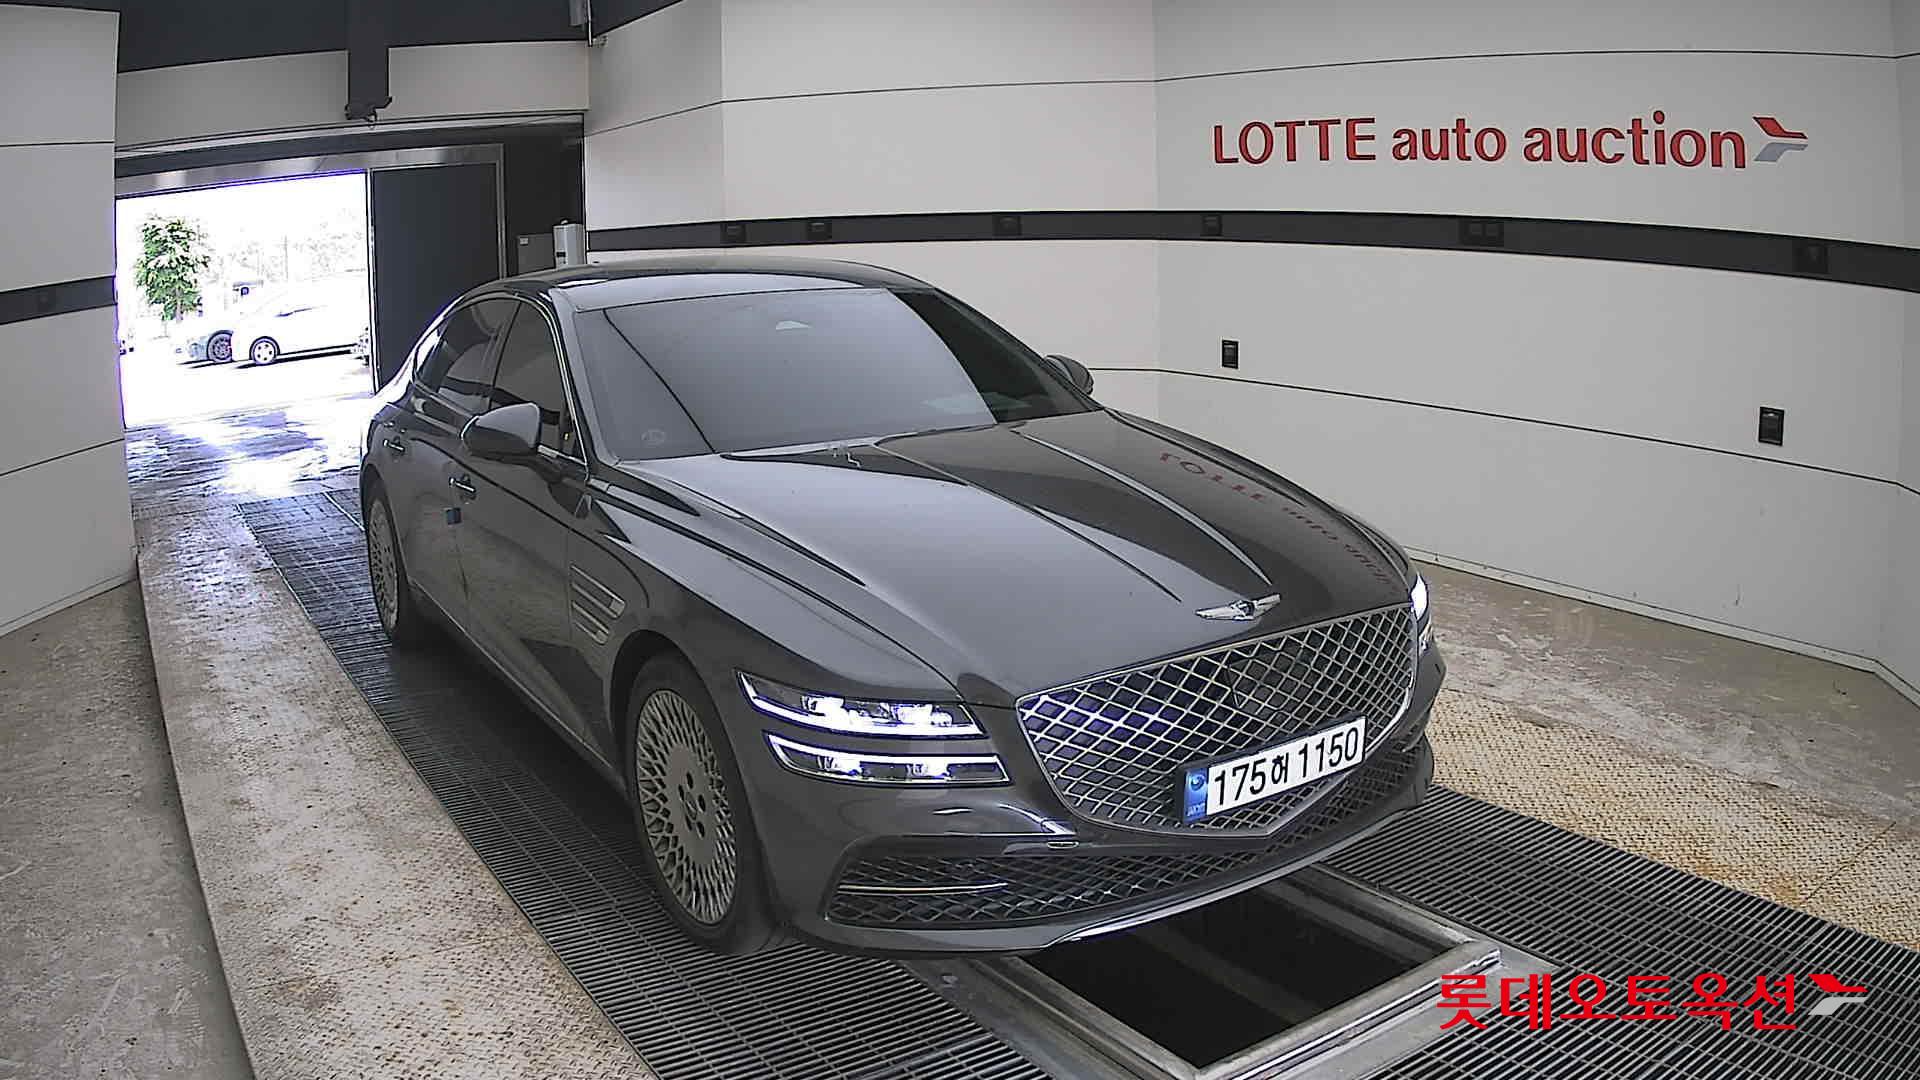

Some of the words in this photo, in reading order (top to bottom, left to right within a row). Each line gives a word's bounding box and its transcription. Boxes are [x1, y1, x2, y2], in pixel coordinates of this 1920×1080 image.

[1213, 118, 1376, 165] LOTTE
[1392, 118, 1508, 162] auto
[1523, 110, 1747, 168] auction
[1214, 752, 1290, 806] 175허
[1298, 727, 1359, 778] 1150
